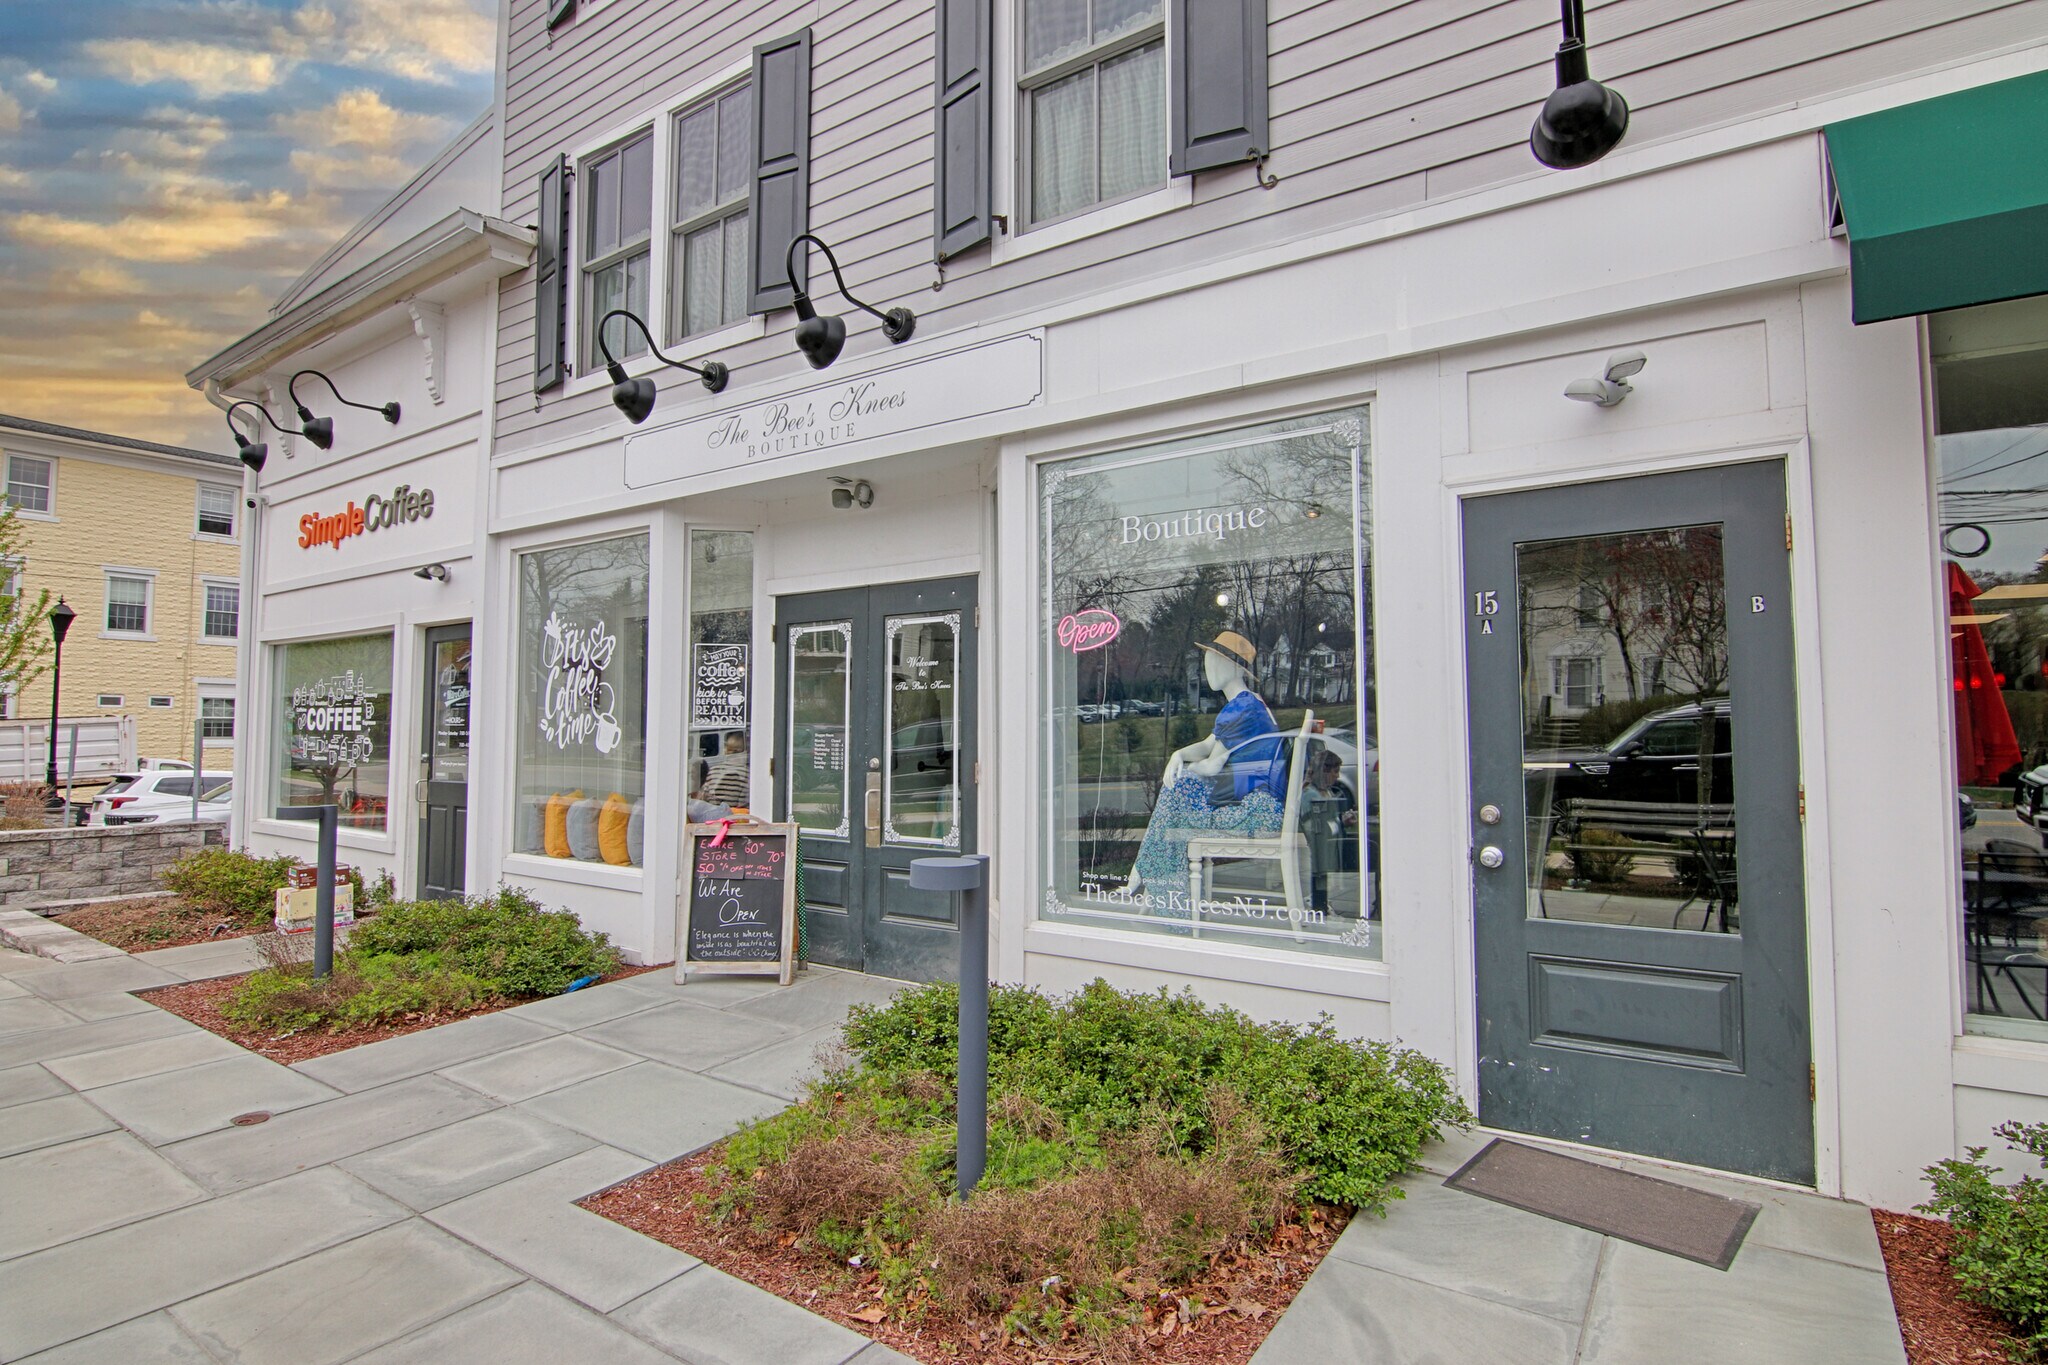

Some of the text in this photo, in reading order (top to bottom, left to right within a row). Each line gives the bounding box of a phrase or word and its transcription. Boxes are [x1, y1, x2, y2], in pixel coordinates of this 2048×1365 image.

[707, 381, 906, 449] The Bee's Knees
[748, 422, 856, 458] BOUTIQUE
[1120, 507, 1266, 545] Boutique
[1475, 590, 1498, 616] 15
[1751, 596, 1765, 613] B
[1058, 615, 1116, 654] Open
[1481, 619, 1493, 635] A
[563, 629, 591, 671] It's
[711, 649, 737, 661] MAY YOUR
[698, 662, 745, 677] coffee
[907, 656, 939, 668] Welcome
[918, 668, 927, 677] to
[545, 665, 598, 719] Coffee
[696, 687, 727, 697] kick in
[895, 680, 951, 691] The Bee's Knees
[695, 705, 743, 715] REALITY
[306, 707, 362, 731] COFFEE
[711, 715, 743, 725] DOES
[555, 711, 597, 749] time
[700, 851, 738, 861] STORE
[697, 863, 715, 873] 50
[1082, 871, 1098, 880] Shop
[1110, 873, 1122, 881] line
[1143, 877, 1156, 885] pick
[699, 879, 744, 898] We Are
[1080, 882, 1326, 925] TheBeesKneesNJ.com
[762, 930, 774, 938] the
